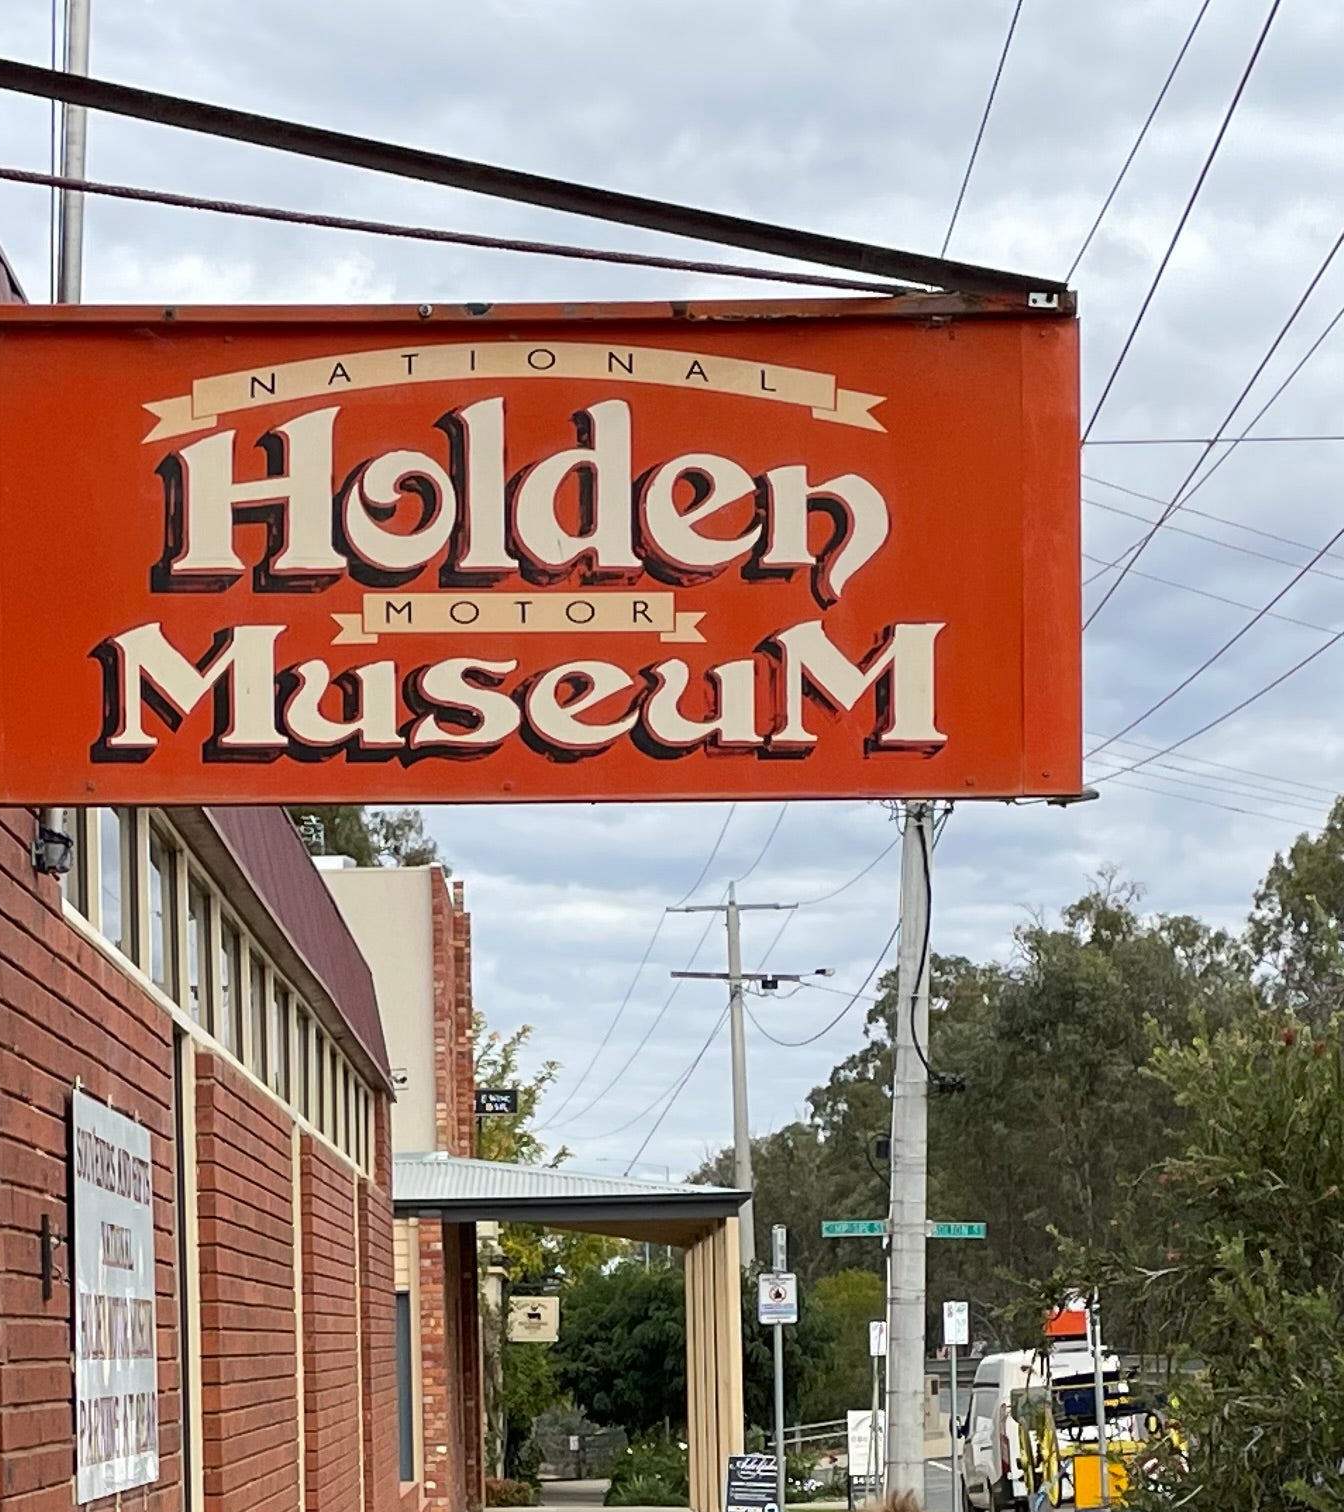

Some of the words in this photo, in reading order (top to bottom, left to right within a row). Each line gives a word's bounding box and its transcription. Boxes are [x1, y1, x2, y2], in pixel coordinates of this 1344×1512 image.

[250, 348, 776, 399] NATIONAL
[150, 397, 892, 610] Holden
[385, 600, 653, 624] MOTOR
[88, 619, 949, 768] MuseuM
